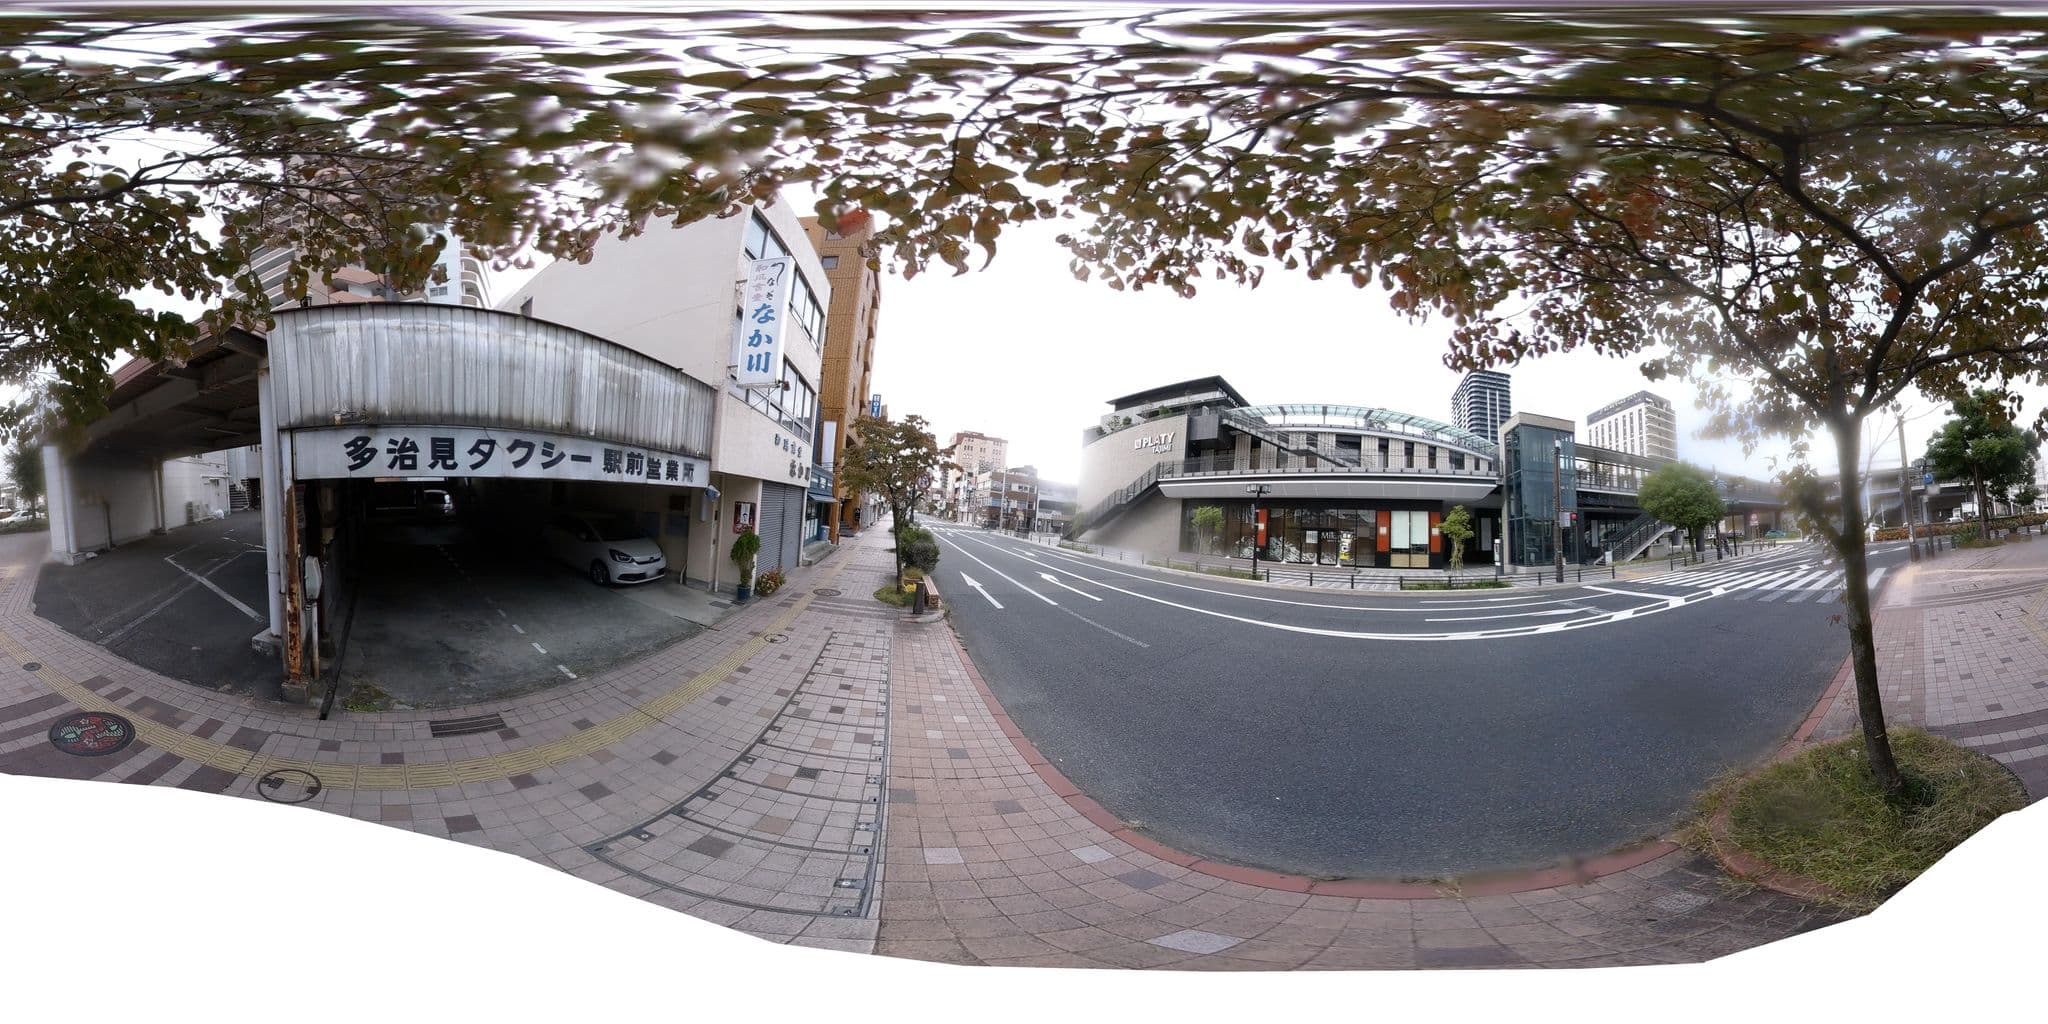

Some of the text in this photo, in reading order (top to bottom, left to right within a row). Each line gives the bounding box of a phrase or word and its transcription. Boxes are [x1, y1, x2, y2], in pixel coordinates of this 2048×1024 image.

[747, 303, 776, 373] なか川
[343, 435, 593, 472] 多治見タクシー
[1142, 432, 1176, 449] PLATY
